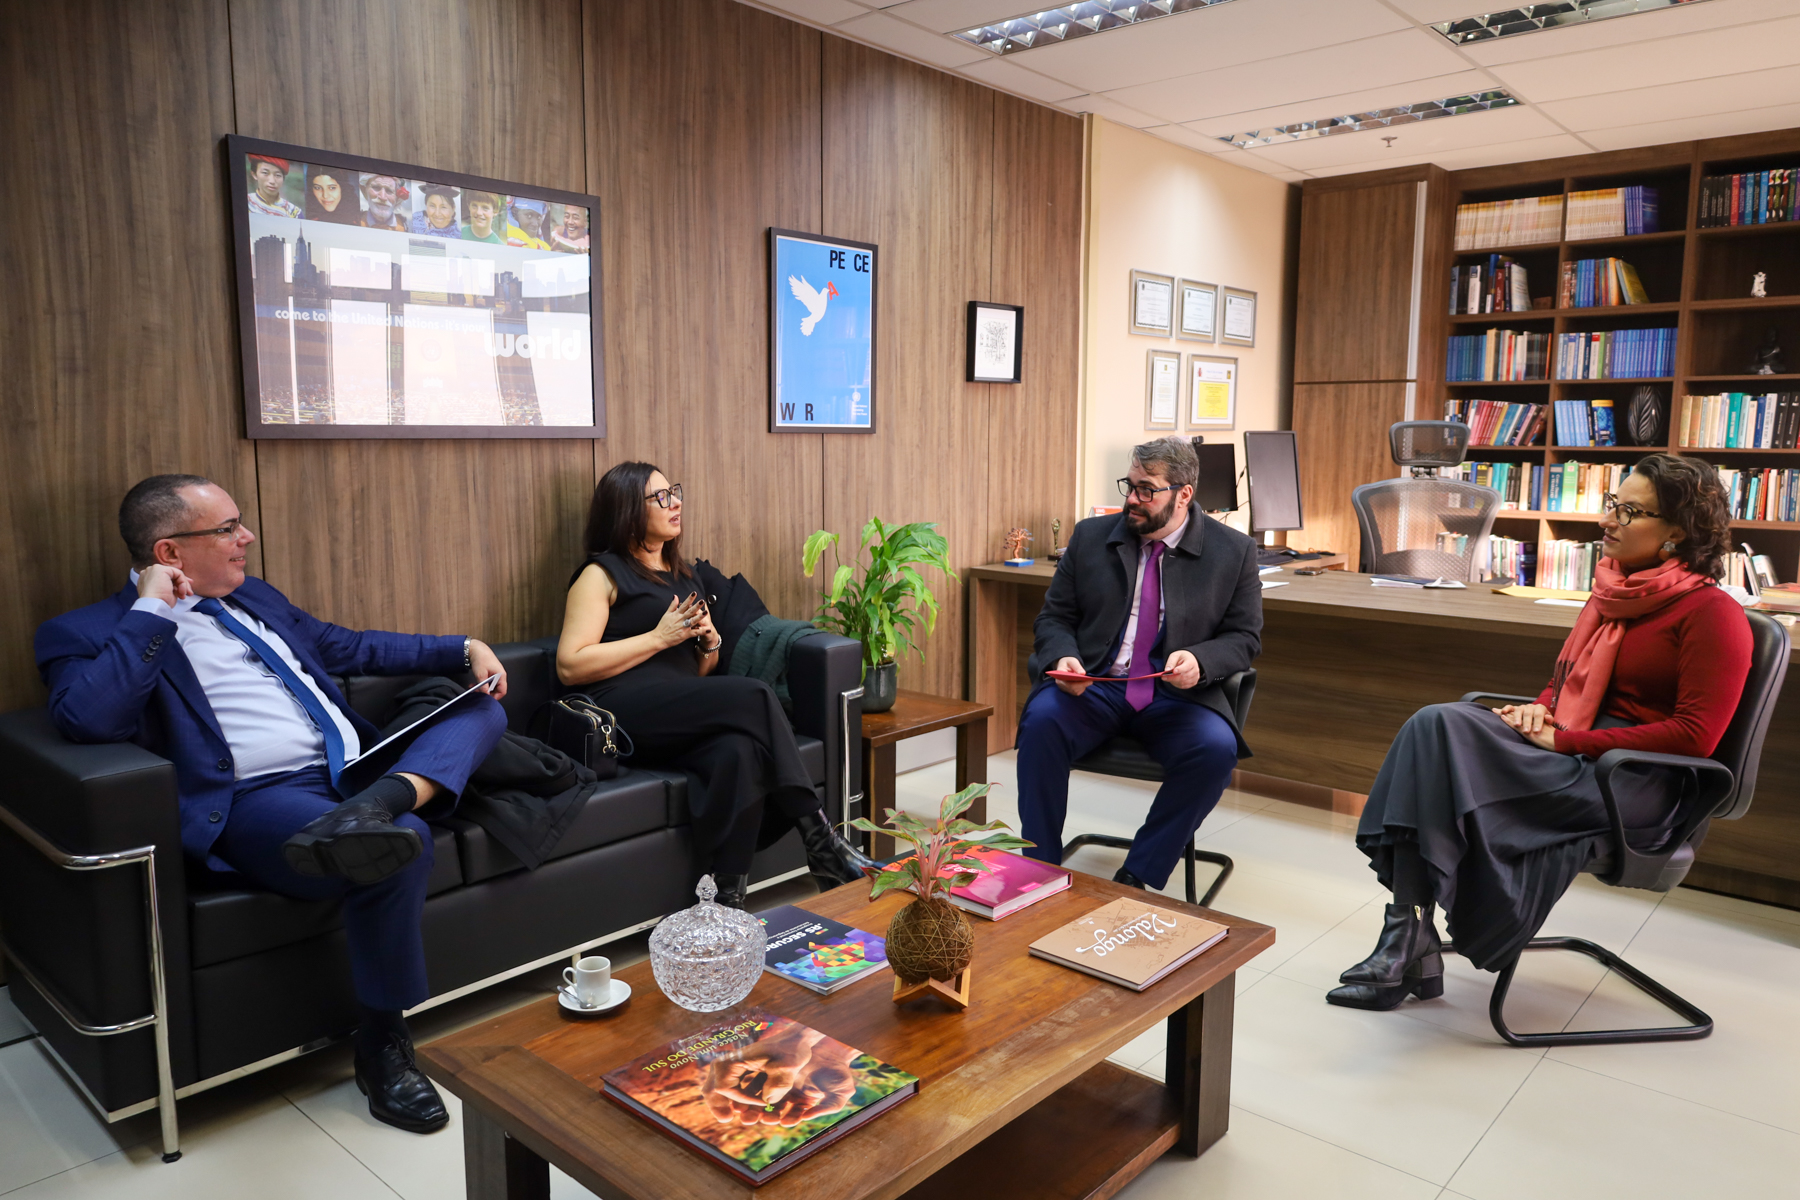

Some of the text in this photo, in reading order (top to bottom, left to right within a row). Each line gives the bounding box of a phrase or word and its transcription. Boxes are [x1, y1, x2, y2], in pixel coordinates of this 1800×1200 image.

[275, 309, 311, 321] come
[312, 310, 327, 322] to
[328, 311, 349, 323] the
[351, 312, 392, 327] United
[395, 315, 440, 331] Nations
[462, 323, 486, 335] your
[483, 328, 581, 361] world
[1075, 913, 1177, 957] Valongo
[734, 1020, 757, 1032] RIO
[686, 1029, 735, 1053] GRANDE
[718, 1031, 748, 1047] Nasce
[667, 1050, 687, 1062] DO
[699, 1045, 717, 1055] um
[642, 1059, 668, 1073] SUL
[669, 1053, 699, 1070] Novo
